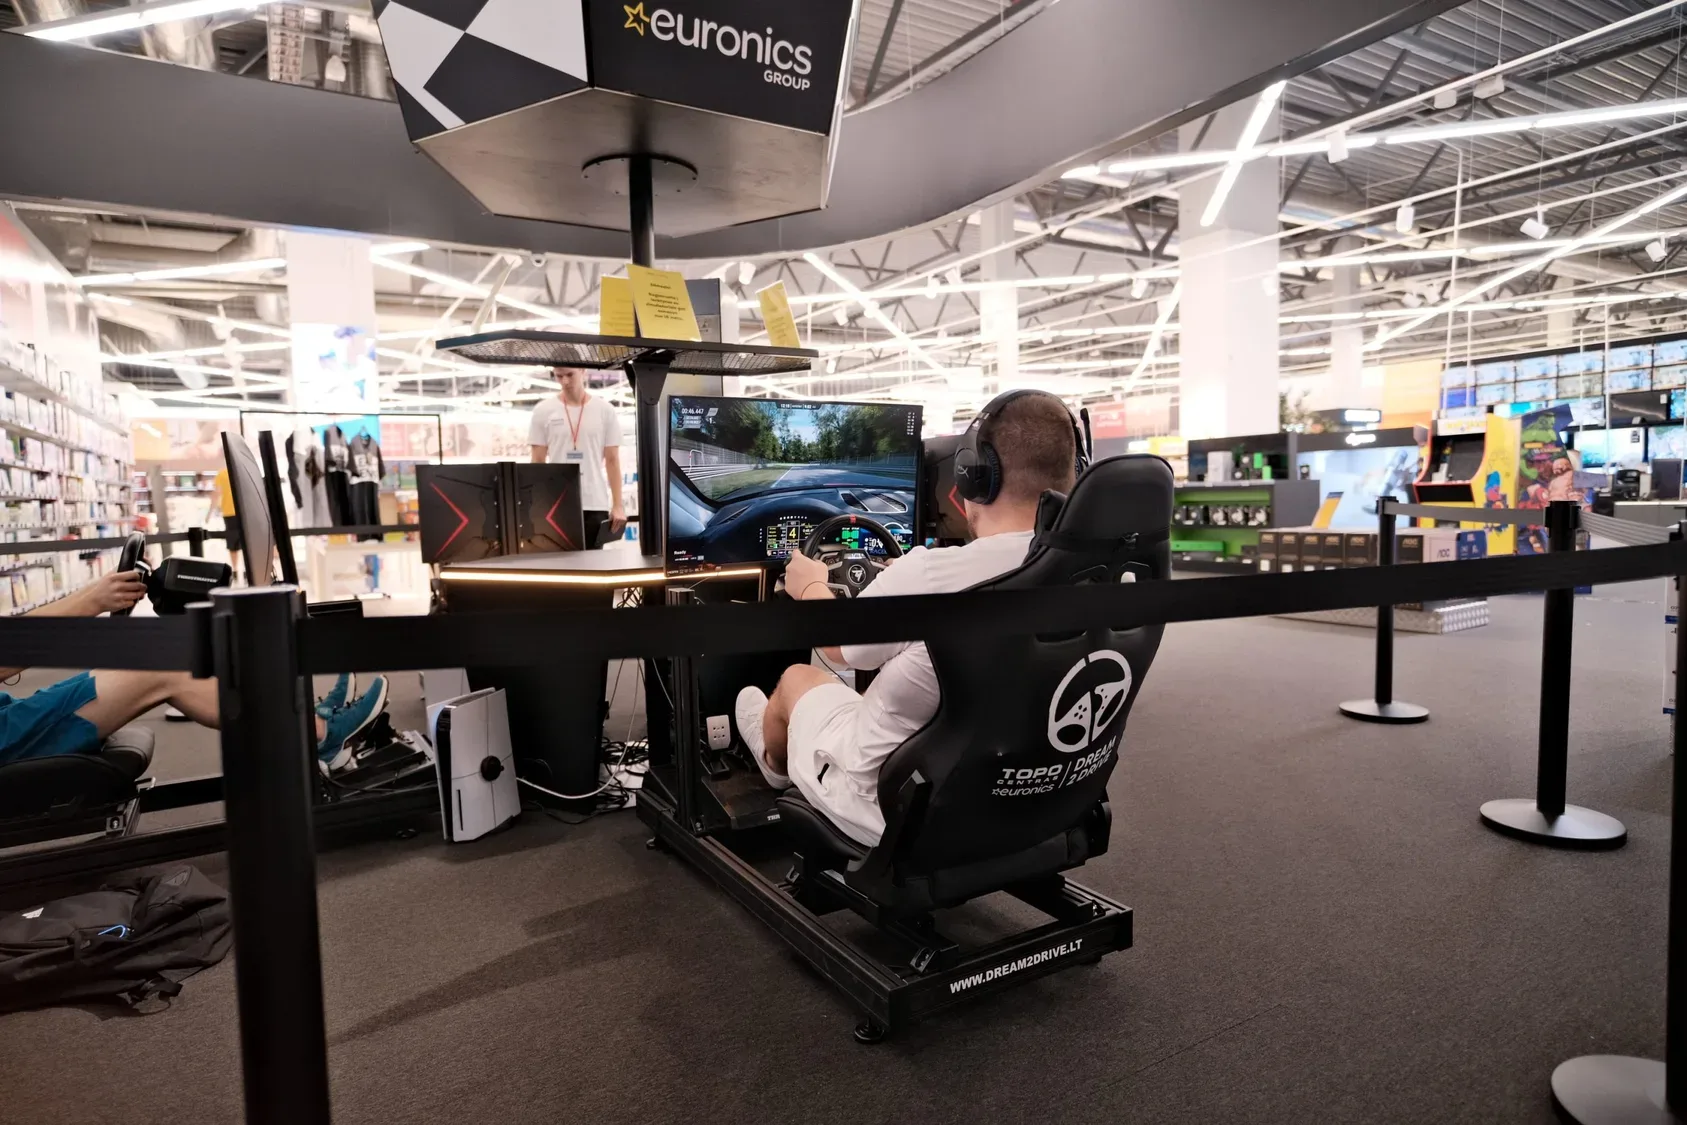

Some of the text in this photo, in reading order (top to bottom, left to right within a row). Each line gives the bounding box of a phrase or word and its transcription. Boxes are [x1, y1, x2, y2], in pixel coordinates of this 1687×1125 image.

[650, 9, 813, 75] euronics
[763, 70, 811, 91] GROUP
[788, 527, 797, 539] 4
[1073, 735, 1117, 772] DREAM
[996, 775, 1059, 785] CENTRAS
[1001, 764, 1063, 780] TOPO
[999, 783, 1055, 797] euronics
[949, 938, 1083, 994] WWW.DREAM2DRIVE.LT
